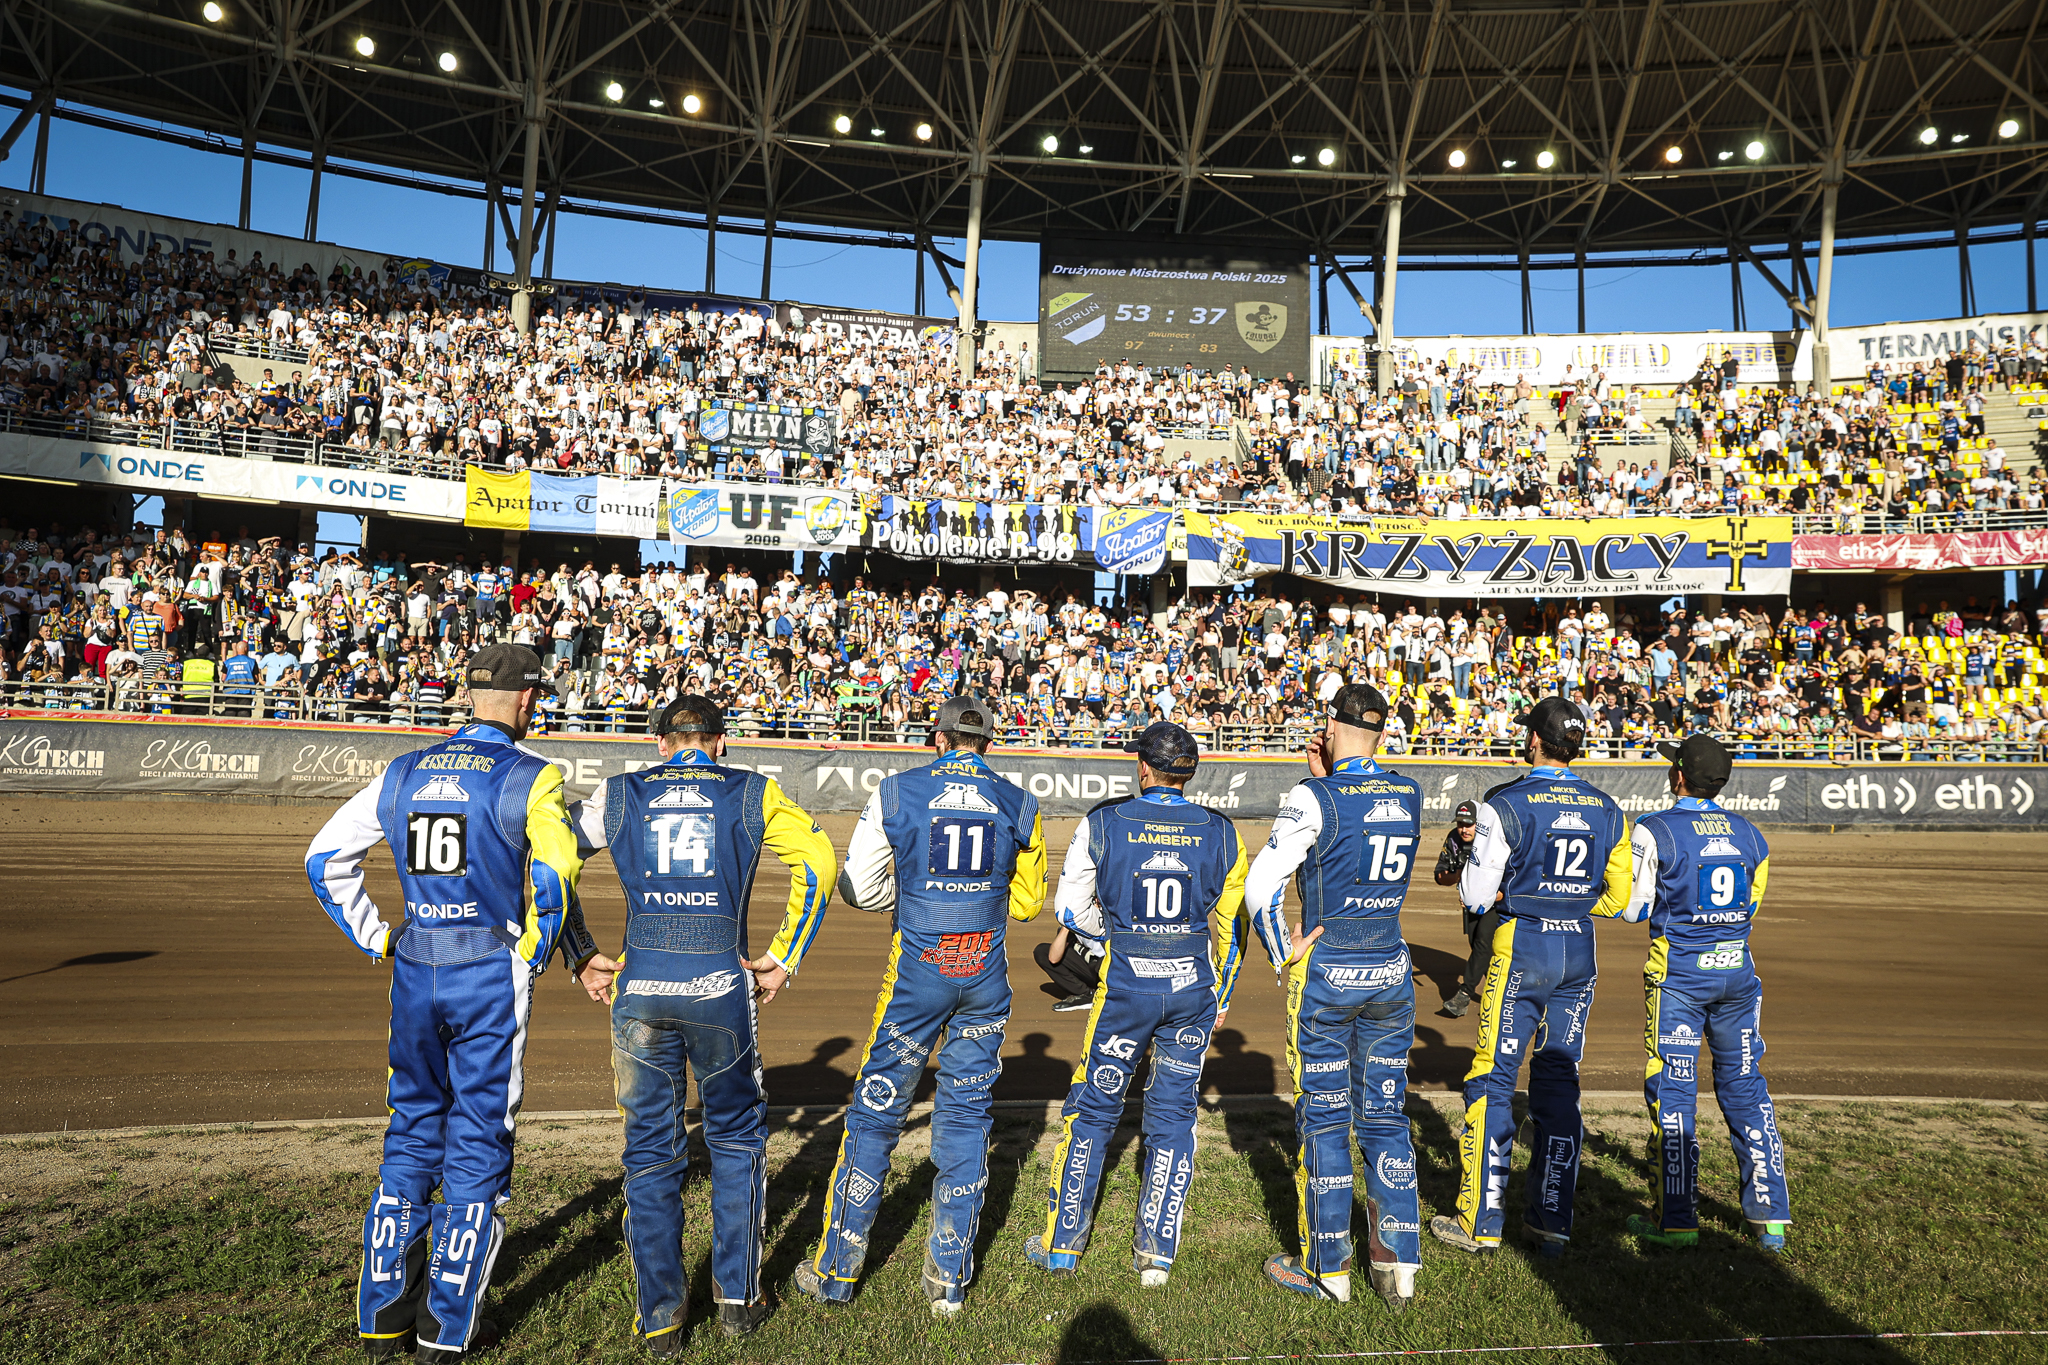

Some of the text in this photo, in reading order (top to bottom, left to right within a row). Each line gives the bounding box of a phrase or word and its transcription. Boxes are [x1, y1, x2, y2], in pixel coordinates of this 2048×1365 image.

[1052, 264, 1287, 284] Drużynowe Mistrzostwa Polski 2025
[1054, 296, 1071, 308] KS
[832, 314, 856, 322] ZAWSZE
[865, 316, 887, 324] NASZEJ
[888, 318, 914, 327] PAMIĘCI
[1054, 302, 1099, 330] TORUŃ
[1114, 304, 1151, 322] 53
[1189, 307, 1227, 325] 37
[849, 323, 920, 351] RYBA
[1124, 340, 1143, 350] 97
[1199, 343, 1218, 353] 83
[1859, 319, 2048, 361] TERMIŃSK
[732, 411, 802, 440] MŁYN
[117, 457, 205, 482] ONDE
[328, 478, 407, 502] ONDE
[467, 487, 564, 515] Apator
[574, 494, 655, 519] Toruń
[674, 496, 716, 529] Apator
[729, 492, 799, 531] UF
[1105, 511, 1128, 532] KS
[745, 534, 781, 545] 2008
[815, 532, 835, 541] 2008
[871, 521, 1003, 560] Pokolenie
[1102, 522, 1165, 566] Apator
[1277, 529, 1690, 586] KRZYŻACY
[1489, 581, 1705, 594] ALE NAJWAŻNIEJSZA JEST WIERNOŚĆ
[1563, 718, 1586, 731] BOLL
[0, 734, 104, 769] KOTECH
[140, 739, 260, 771] EKOTECH
[291, 744, 392, 777] EKOTEC
[3, 767, 103, 777] INSTALACJE SANITARNE
[139, 770, 161, 778] SIECI
[168, 771, 216, 780] INSTALACJE
[216, 772, 259, 780] SANITARNE
[940, 762, 978, 774] JAN
[291, 774, 310, 783] SIECI
[317, 775, 362, 784] INSTALACJE
[429, 775, 460, 783] ZDB
[944, 782, 979, 794] ZDB
[1029, 773, 1132, 799] ONDE
[666, 785, 700, 793] ZDB
[1550, 786, 1580, 794] MIKKEL
[1820, 774, 1887, 810] eth
[1934, 774, 2004, 810] eth
[935, 804, 991, 812] ROGOWO
[1373, 799, 1401, 807] ZDB
[1527, 794, 1603, 808] MICHELSEN
[1713, 792, 1780, 811] Raitech
[1145, 824, 1185, 833] ROBERT
[1691, 820, 1735, 836] DUDEK
[409, 816, 460, 872] 16
[651, 818, 709, 874] 14
[943, 825, 984, 870] 11
[1127, 832, 1203, 847] LAMBERT
[1152, 850, 1179, 858] ZDB
[1368, 834, 1413, 882] 15
[1554, 838, 1588, 878] 12
[945, 882, 991, 892] ONDE
[1553, 883, 1591, 894] ONDE
[1710, 866, 1735, 907] 9
[663, 892, 718, 906] ONDE
[1142, 878, 1182, 919] 10
[1364, 896, 1403, 909] ONDE
[419, 902, 478, 919] ONDE
[1710, 911, 1747, 923] ONDE
[1149, 924, 1191, 933] ONDE
[939, 931, 993, 953] 201
[920, 952, 981, 964] KVECH
[1699, 950, 1743, 968] 692
[1333, 979, 1385, 987] SPEEDWAY
[1478, 957, 1502, 1050] GARCAREK
[1502, 970, 1524, 1034] DURAJ RECK
[1098, 1034, 1138, 1057] JG
[1164, 1056, 1176, 1065] Jörg
[1305, 1059, 1350, 1073] BECKHOFF
[1672, 1058, 1689, 1068] MU
[953, 1065, 1001, 1087] MERCURE
[1674, 1067, 1690, 1078] RA
[1384, 1157, 1413, 1169] Plech
[1460, 1119, 1476, 1214] GARCAREK
[851, 1172, 873, 1191] SPEED
[1062, 1137, 1091, 1230] GARCAREK
[1748, 1146, 1771, 1207] ANLAS
[1161, 1157, 1192, 1239] daytona
[371, 1183, 399, 1282] FST
[1383, 1222, 1419, 1230] MIRTRAN
[441, 1202, 485, 1297] FST
[1270, 1262, 1312, 1288] daytona
